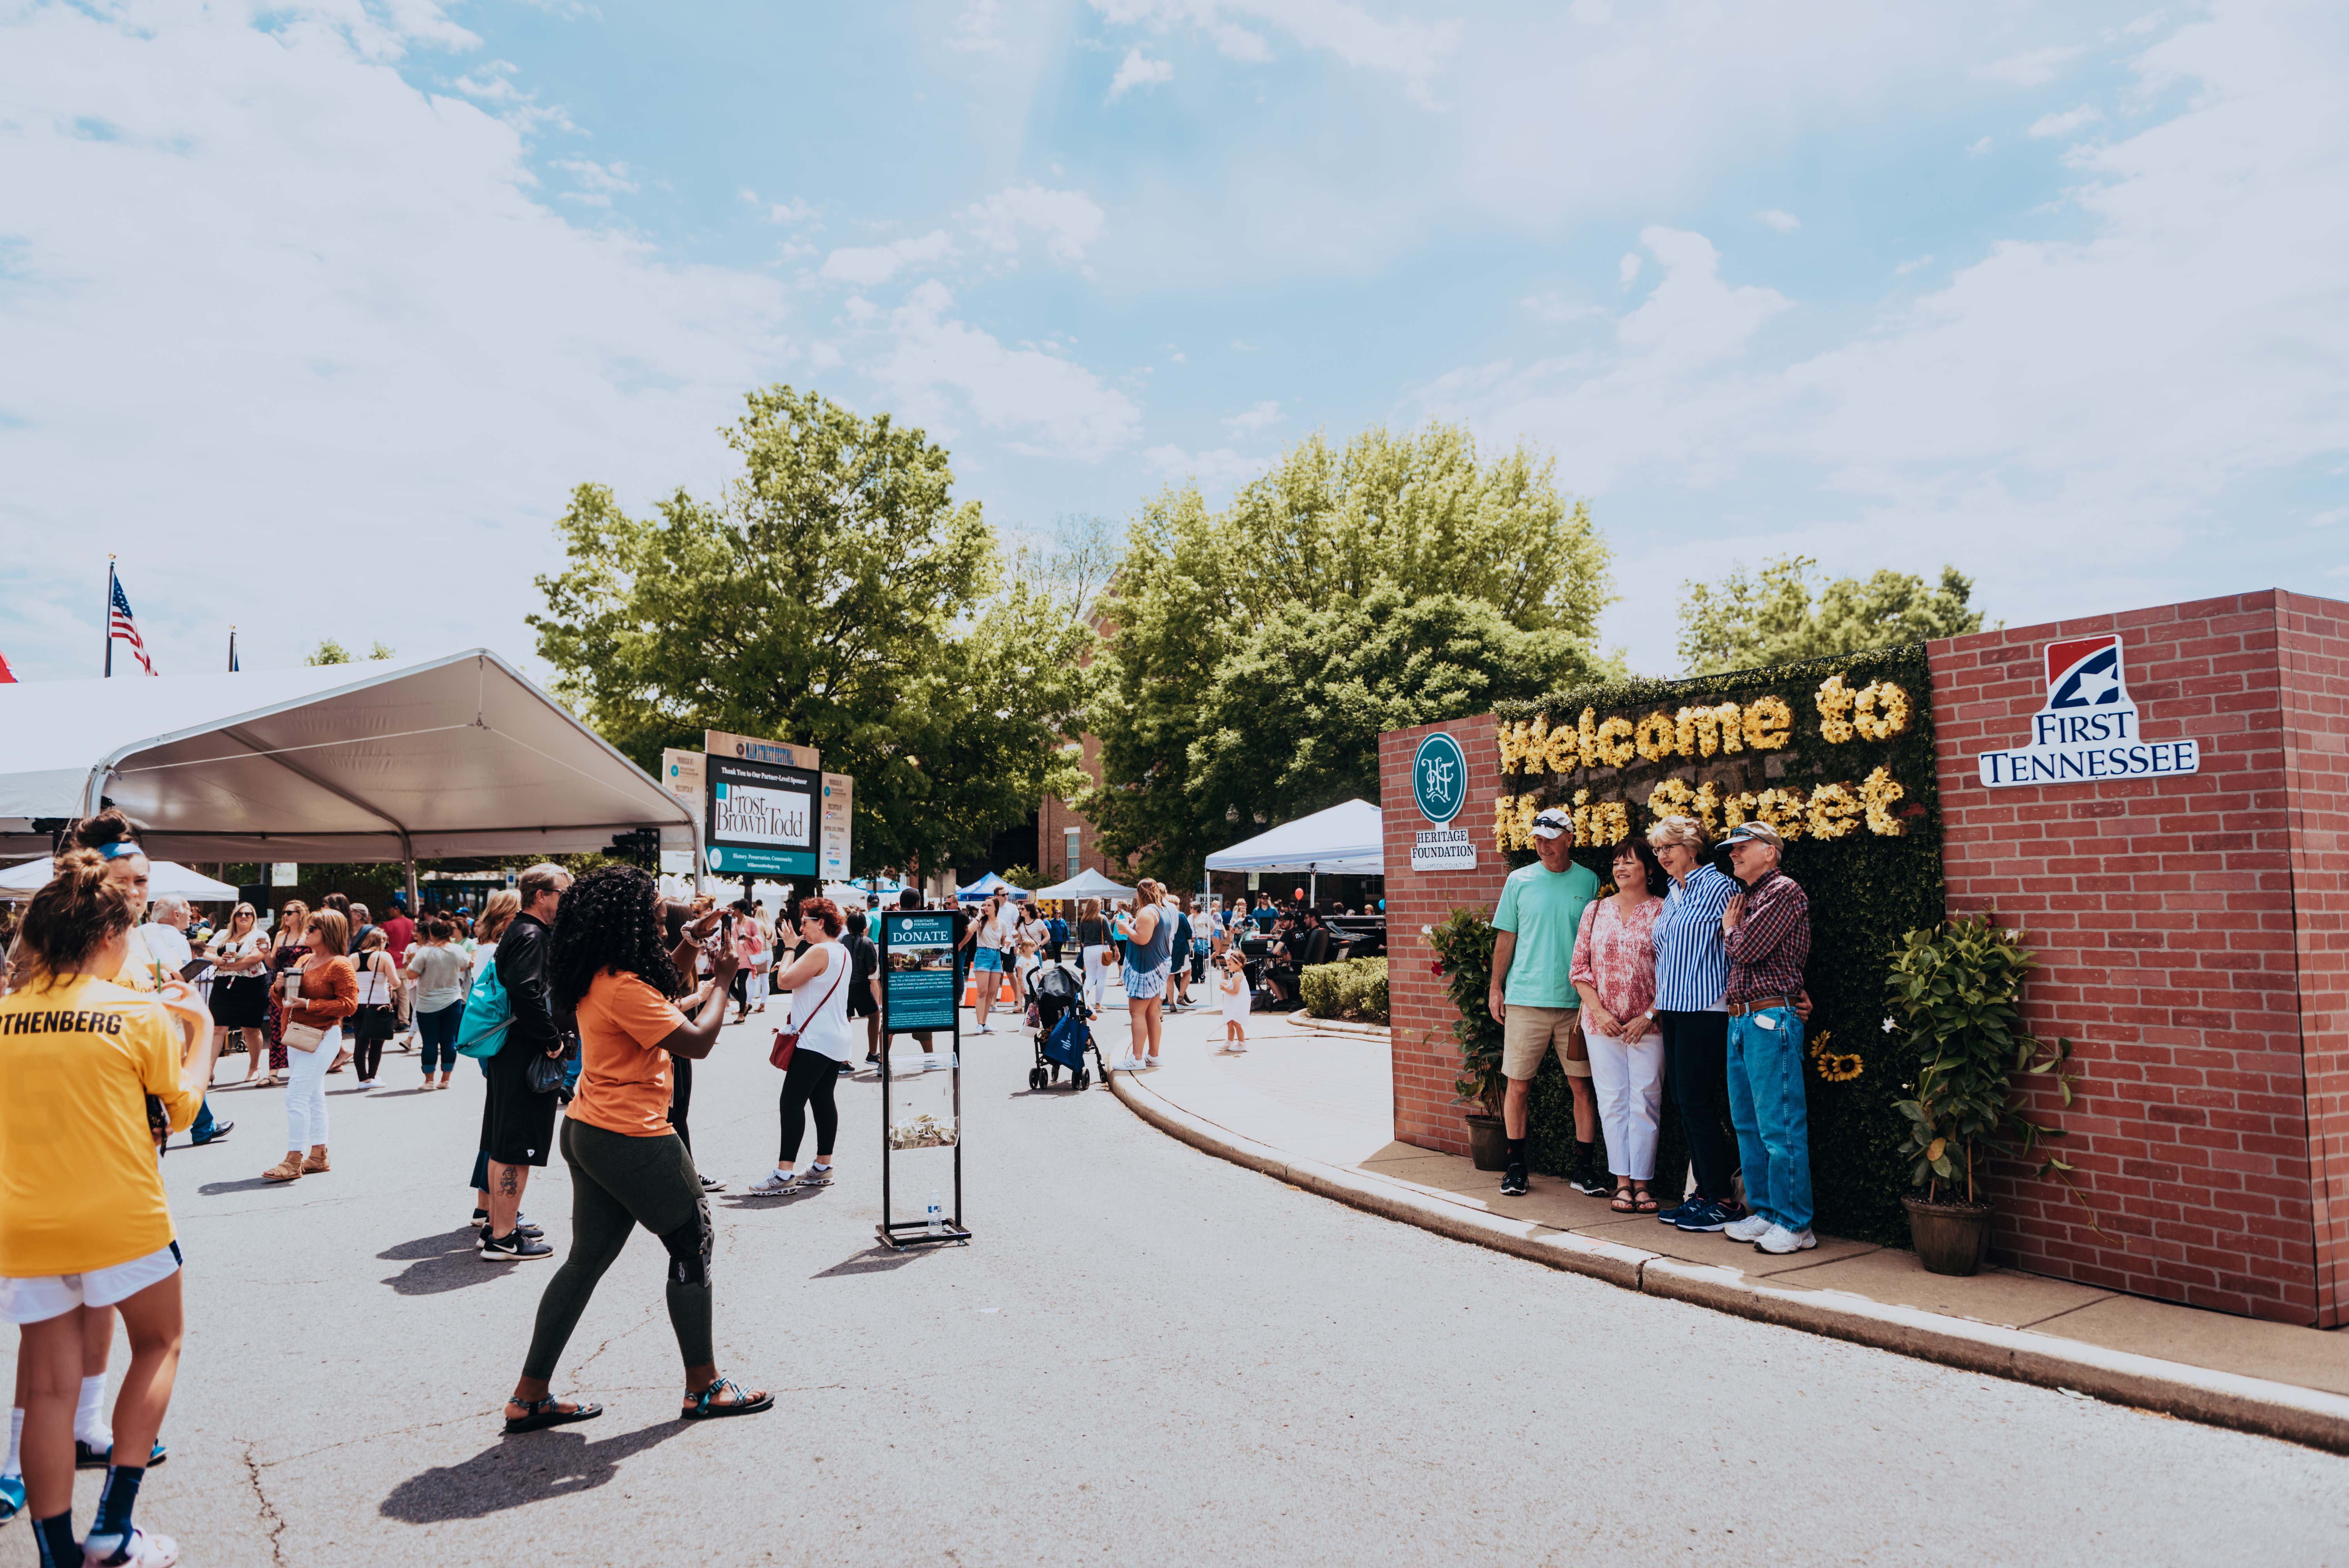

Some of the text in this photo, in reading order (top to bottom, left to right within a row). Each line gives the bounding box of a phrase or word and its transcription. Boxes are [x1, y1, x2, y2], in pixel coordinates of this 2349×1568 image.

[1498, 675, 1909, 774] Welcome to
[2036, 711, 2133, 745] FIRST
[746, 743, 794, 765] MAIN STREET FESTIVAL
[1981, 742, 2195, 783] TENNESSEE
[721, 767, 736, 775] Thank
[761, 772, 790, 782] Partner-Level
[790, 776, 807, 785] Sponsor
[728, 784, 766, 816] Frost
[715, 802, 766, 834] Brown
[766, 807, 802, 837] Todd
[1492, 789, 1630, 853] Min
[771, 838, 802, 846] ATTORNEYS
[1417, 830, 1467, 843] HERITAGE
[1412, 845, 1474, 859] FOUNDATION
[893, 931, 948, 942] DONATE
[0, 1011, 122, 1035] THENBERG
